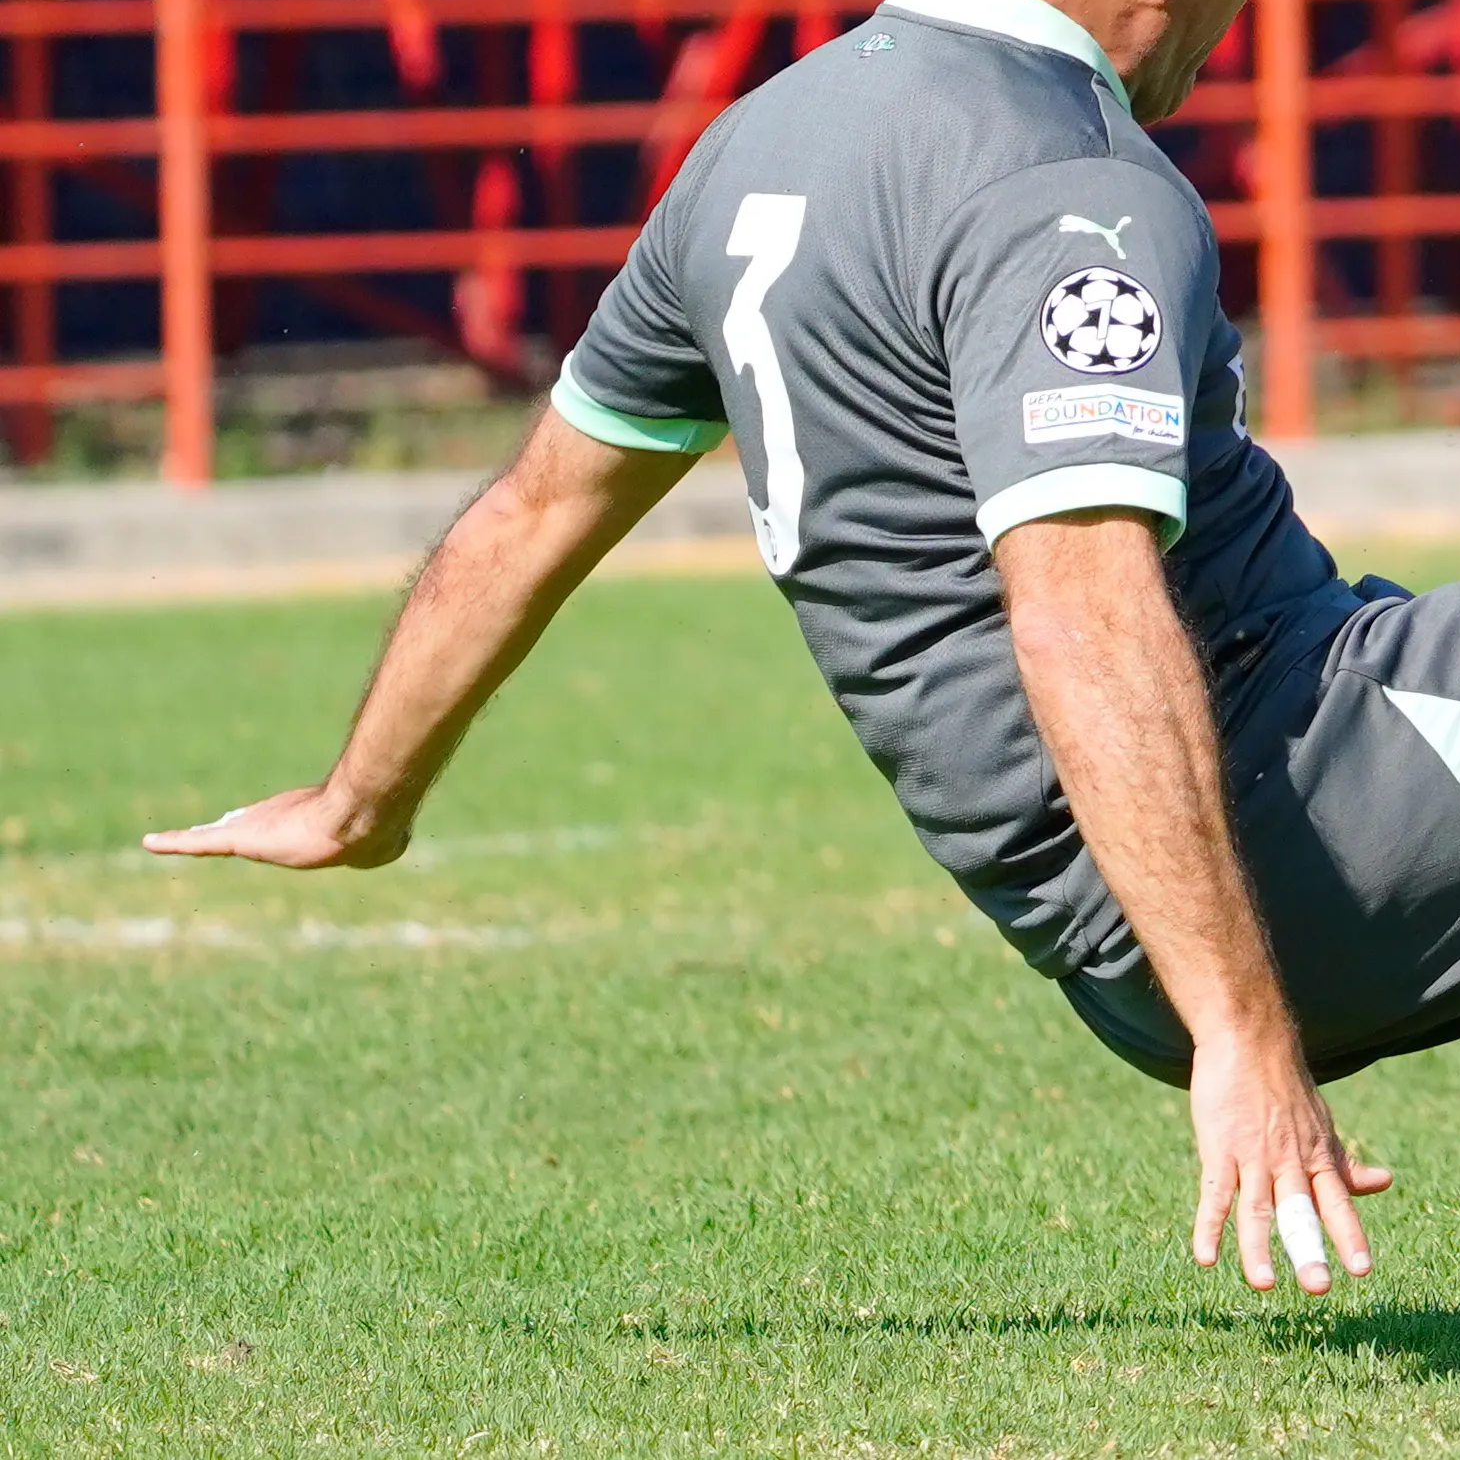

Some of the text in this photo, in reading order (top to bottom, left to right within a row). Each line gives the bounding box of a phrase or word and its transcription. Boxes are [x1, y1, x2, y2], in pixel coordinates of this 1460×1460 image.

[1085, 299, 1113, 341] 7
[723, 192, 806, 576] 3
[1028, 393, 1063, 406] UEFA
[1029, 401, 1179, 426] FOUNDATION
